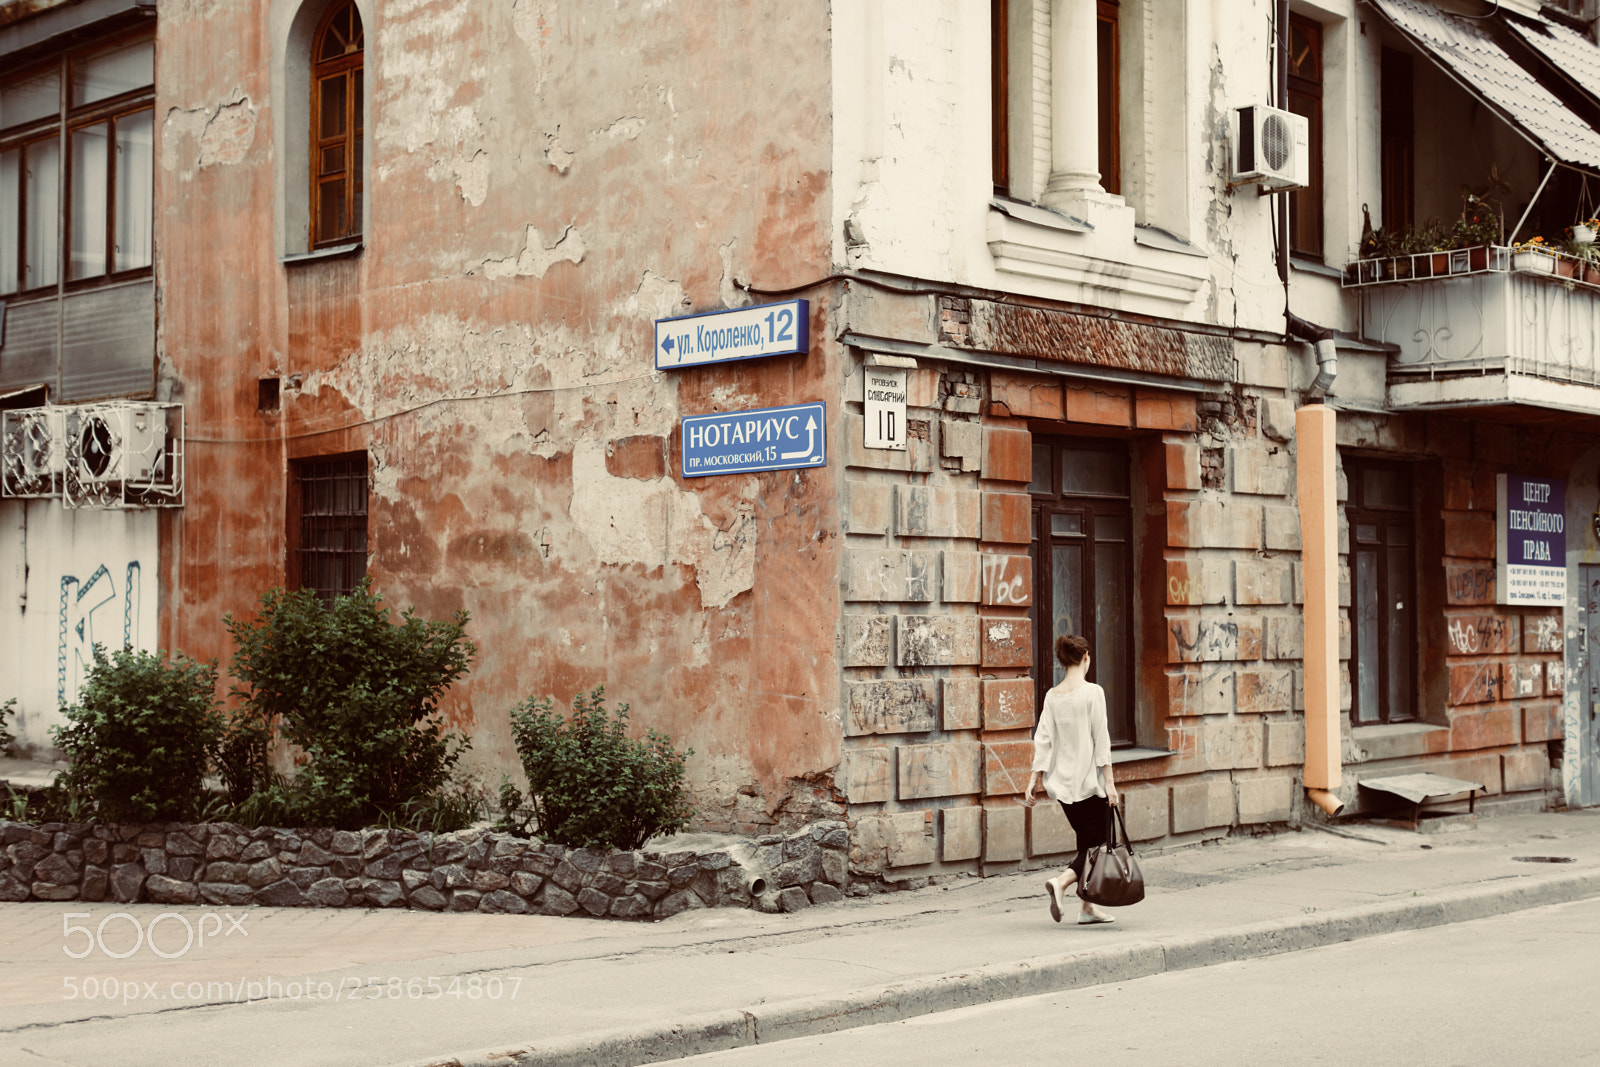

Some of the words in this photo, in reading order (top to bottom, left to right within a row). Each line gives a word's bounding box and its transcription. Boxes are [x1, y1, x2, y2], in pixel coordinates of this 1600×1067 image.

[676, 334, 694, 362] ул.
[697, 324, 764, 357] Короленко,
[764, 308, 793, 343] 12
[690, 416, 799, 448] НОТАРИУС
[879, 410, 895, 441] 10
[690, 457, 703, 468] ПР.
[704, 450, 764, 467] МОСКОВСКИЙ,
[764, 446, 777, 461] 15
[1523, 481, 1551, 506] ЦЕНТР
[1509, 508, 1564, 534] ПЕНСІЙНОГО
[1523, 539, 1552, 561] ПРАВА
